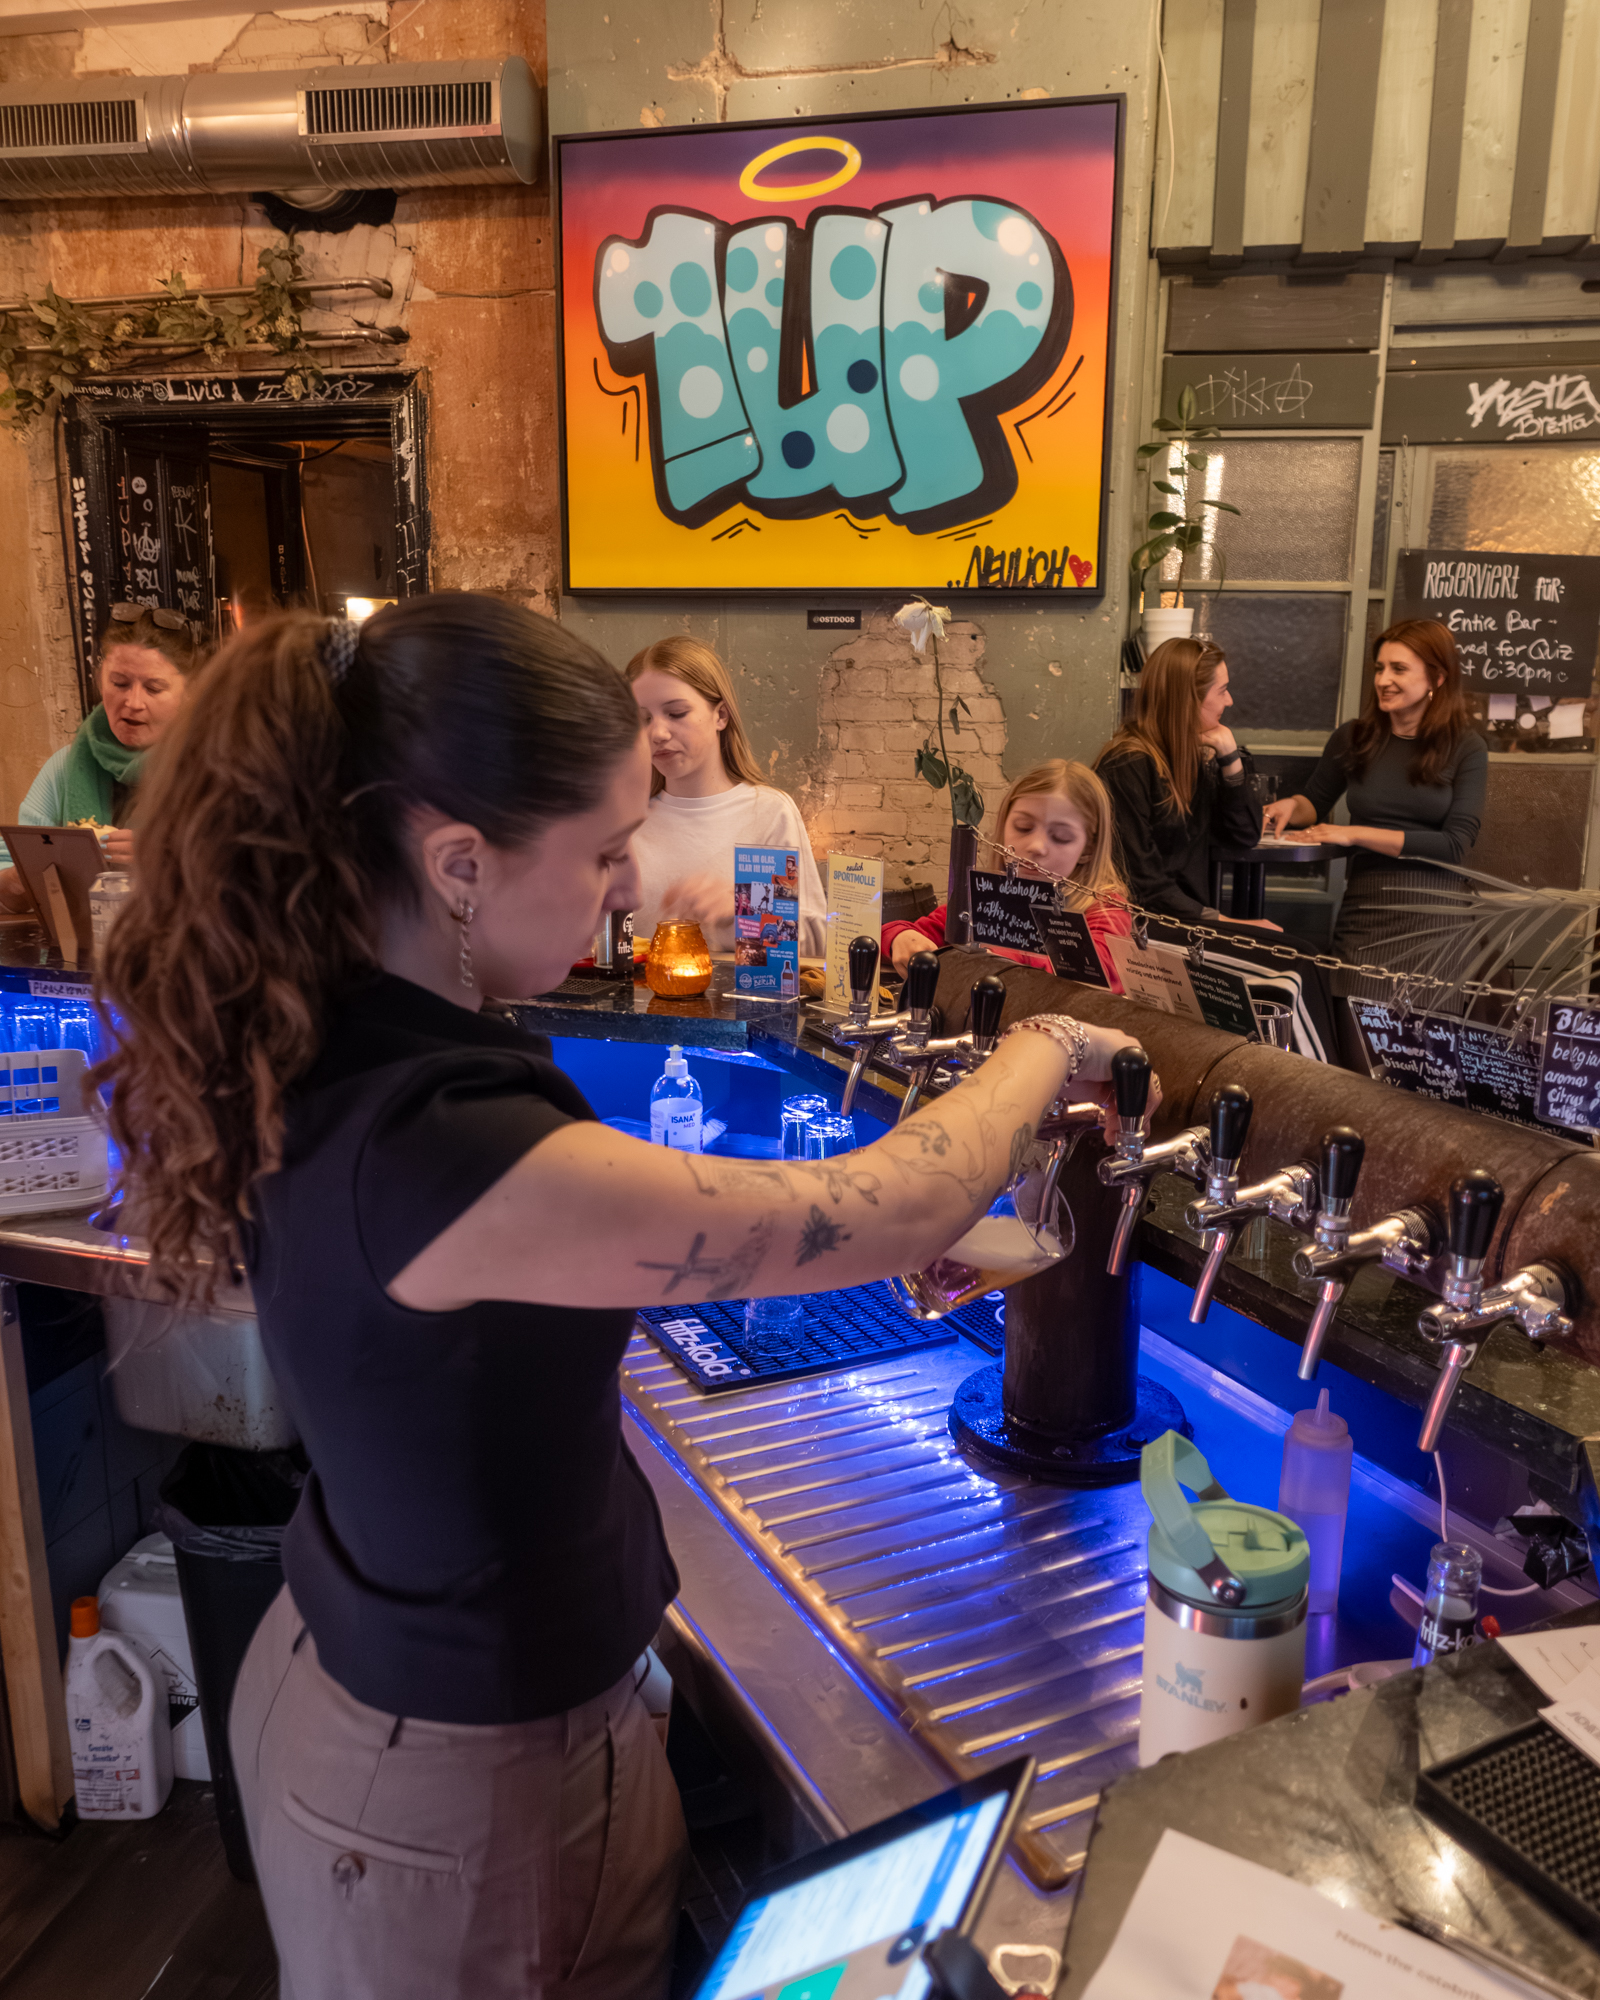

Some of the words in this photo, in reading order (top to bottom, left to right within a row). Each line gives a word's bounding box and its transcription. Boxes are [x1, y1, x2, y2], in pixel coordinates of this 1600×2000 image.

[1447, 608, 1498, 632] Entire
[1506, 609, 1542, 633] Bar
[1496, 639, 1527, 657] for
[1527, 638, 1575, 661] Quiz
[1482, 658, 1552, 688] 6:30pm
[738, 853, 751, 862] HELL
[752, 854, 760, 863] IM
[738, 863, 753, 872] KLAR
[753, 864, 761, 873] IM
[833, 870, 876, 887] SPORTMOLLE
[1544, 1070, 1588, 1088] aromas
[671, 1115, 694, 1124] ISANA
[659, 1318, 738, 1377] fritz-kola
[1156, 1673, 1227, 1714] STANLEY
